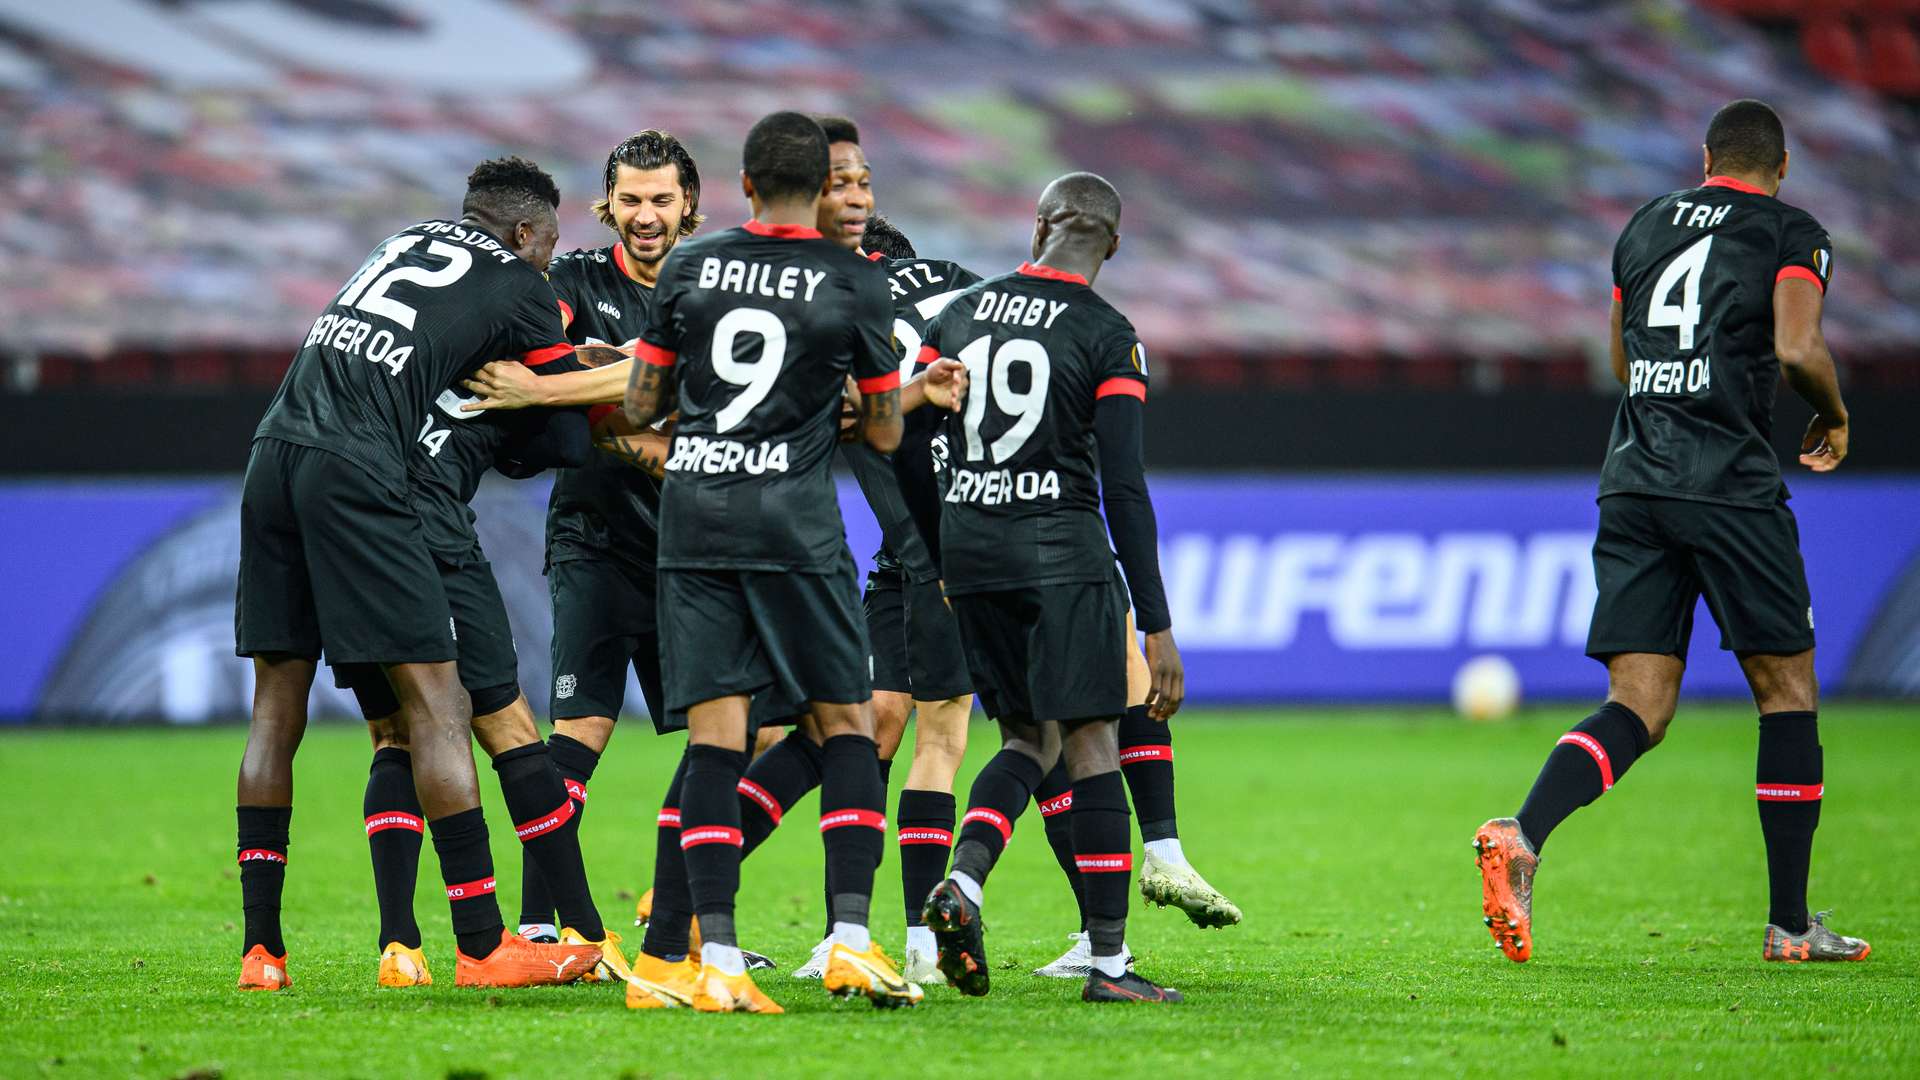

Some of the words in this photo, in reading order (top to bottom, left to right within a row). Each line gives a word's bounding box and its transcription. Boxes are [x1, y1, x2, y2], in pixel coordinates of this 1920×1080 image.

[1673, 202, 1732, 228] TAH
[337, 234, 473, 331] 12
[698, 257, 826, 302] BAILEY
[1648, 234, 1713, 350] 4
[973, 291, 1068, 328] DIABY
[304, 314, 372, 355] BAYER
[366, 329, 415, 377] 04
[711, 307, 787, 434] 9
[1629, 359, 1685, 397] AYER
[957, 334, 1050, 465] 19
[664, 436, 745, 474] BAYER
[1016, 470, 1060, 500] 04
